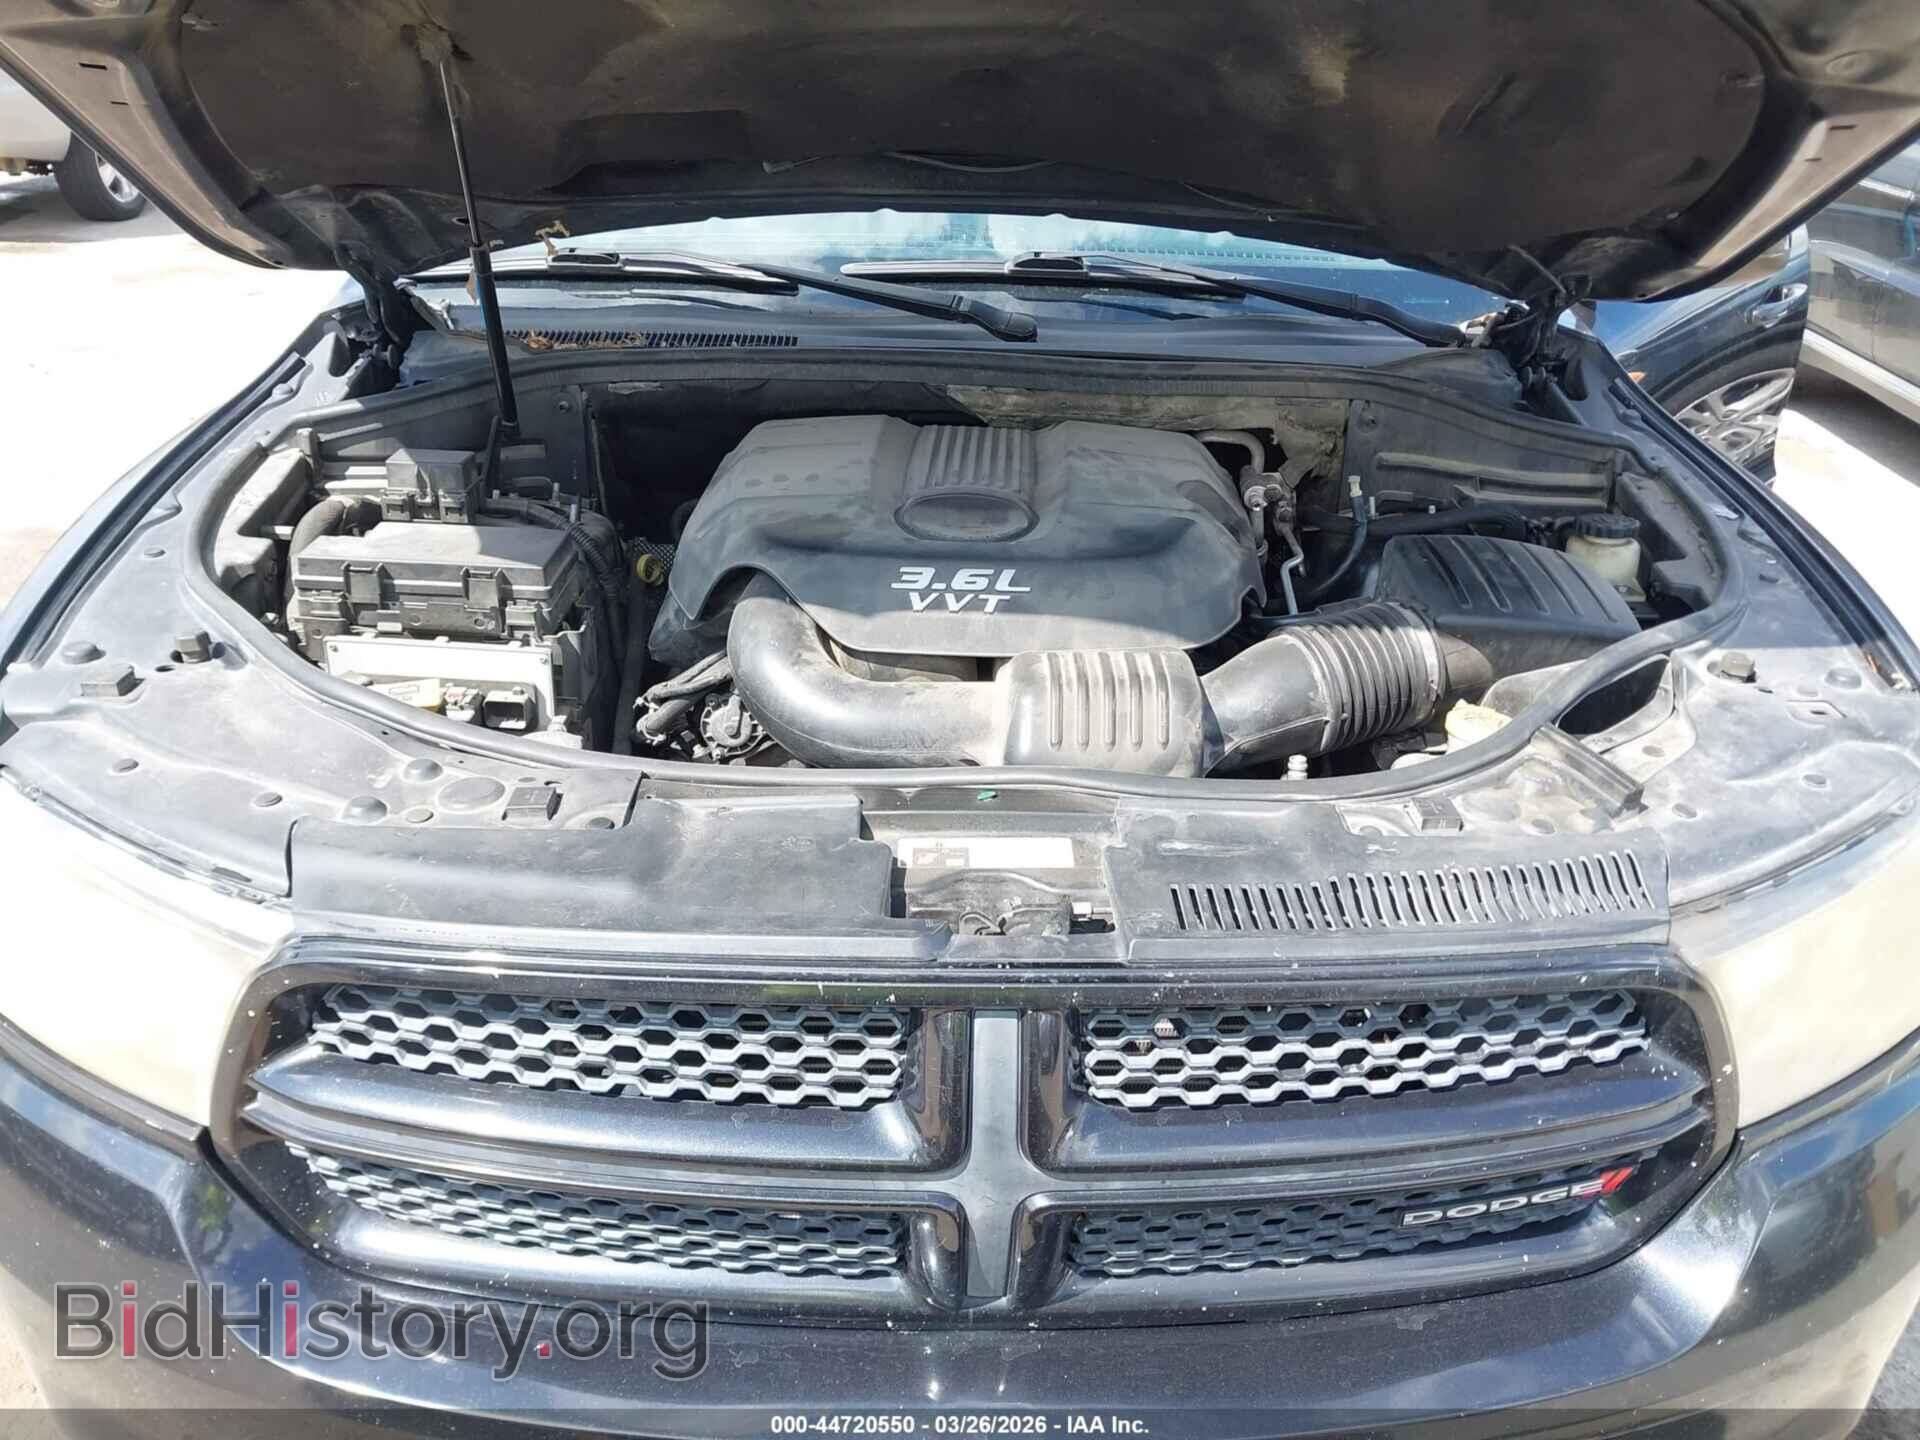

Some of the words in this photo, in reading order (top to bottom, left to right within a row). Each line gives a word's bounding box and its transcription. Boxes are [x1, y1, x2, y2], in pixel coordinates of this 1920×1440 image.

[890, 566, 1032, 592] 3.6L
[908, 591, 1011, 614] VVT
[1402, 1179, 1605, 1226] DODGE
